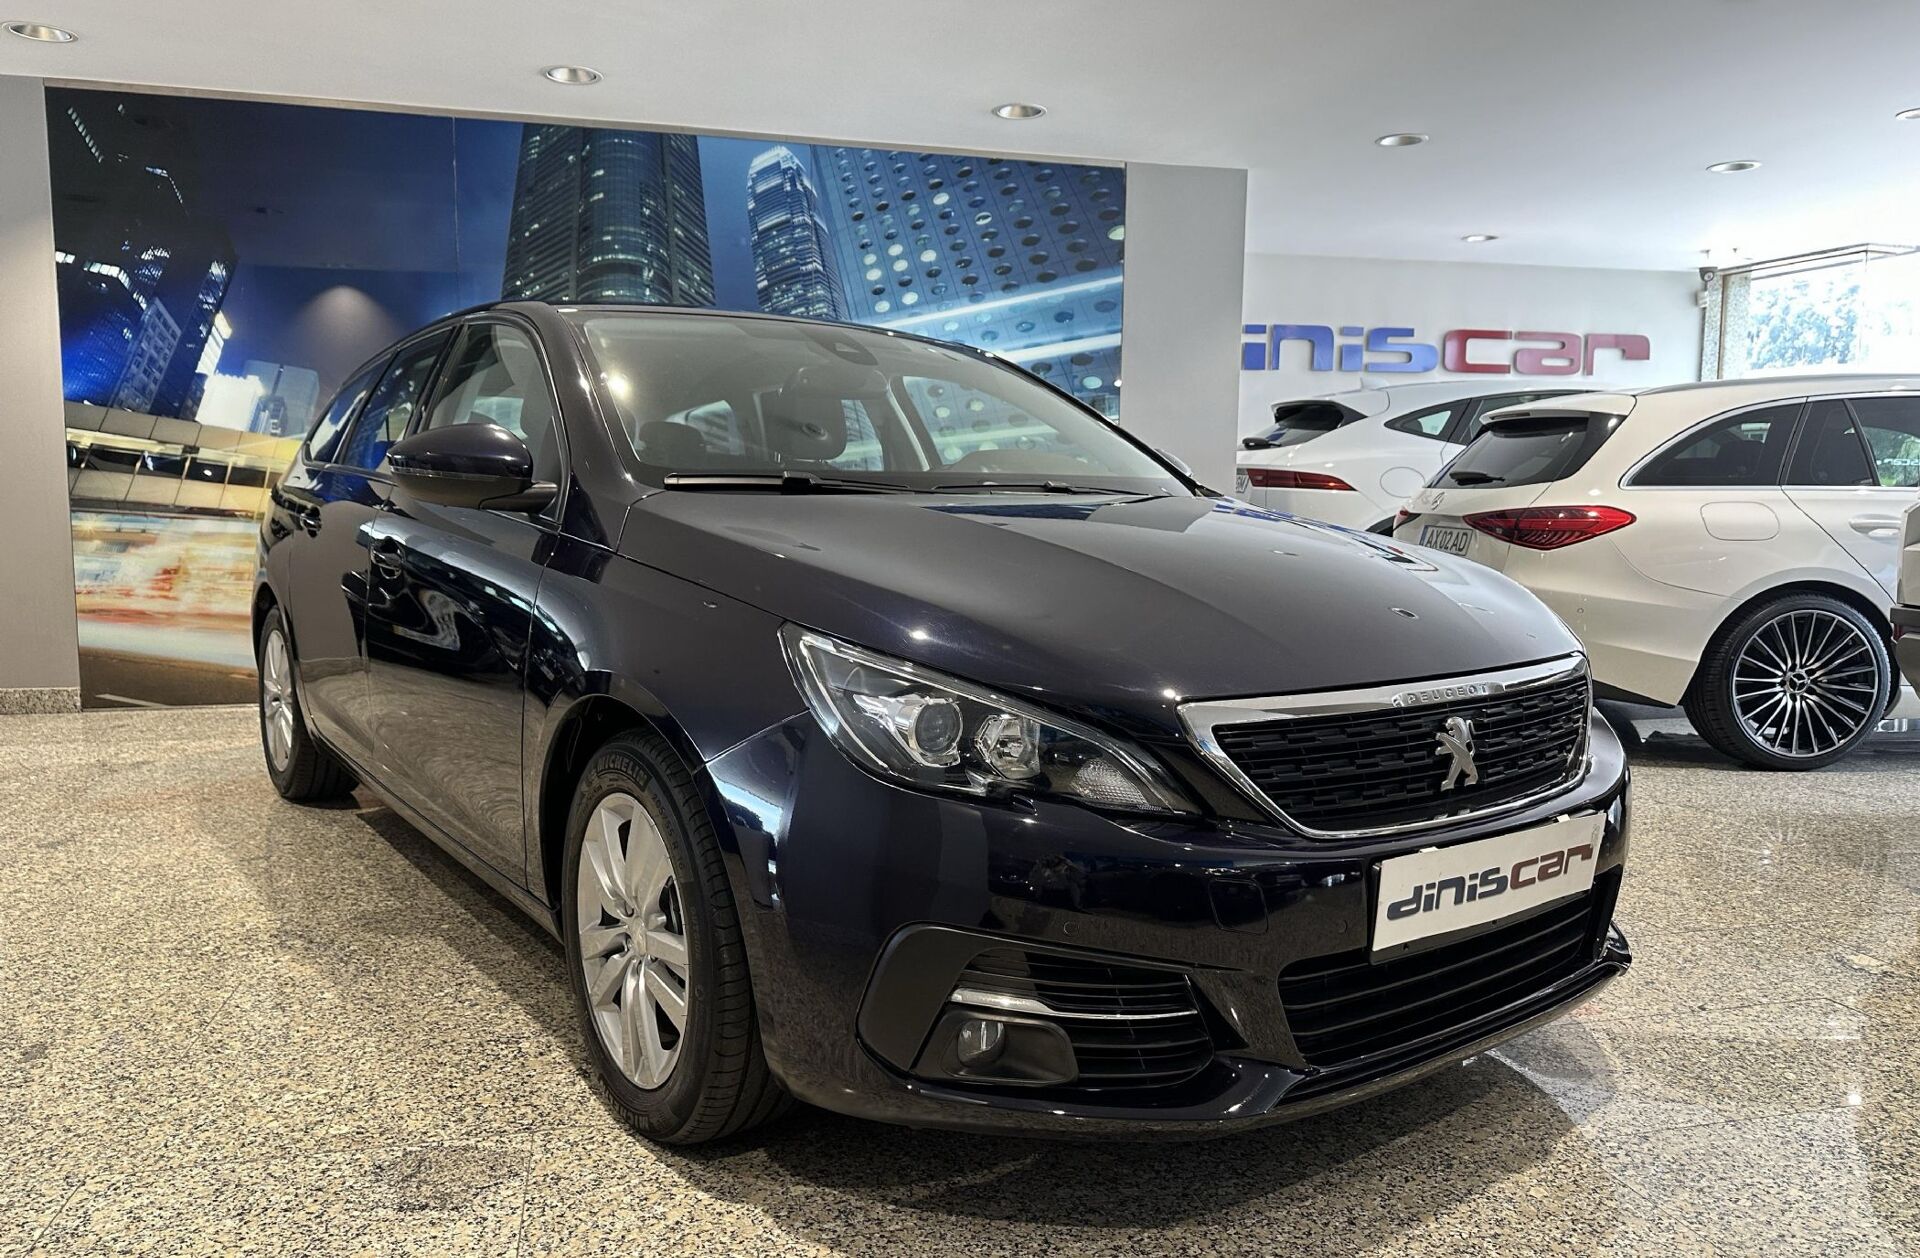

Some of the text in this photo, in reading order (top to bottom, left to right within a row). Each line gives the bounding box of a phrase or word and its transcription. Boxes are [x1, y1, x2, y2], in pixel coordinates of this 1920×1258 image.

[1243, 324, 1650, 376] iniscar
[1407, 683, 1487, 704] PEUGEOT
[597, 755, 650, 788] MICHELIN
[1387, 844, 1593, 920] diniscar
